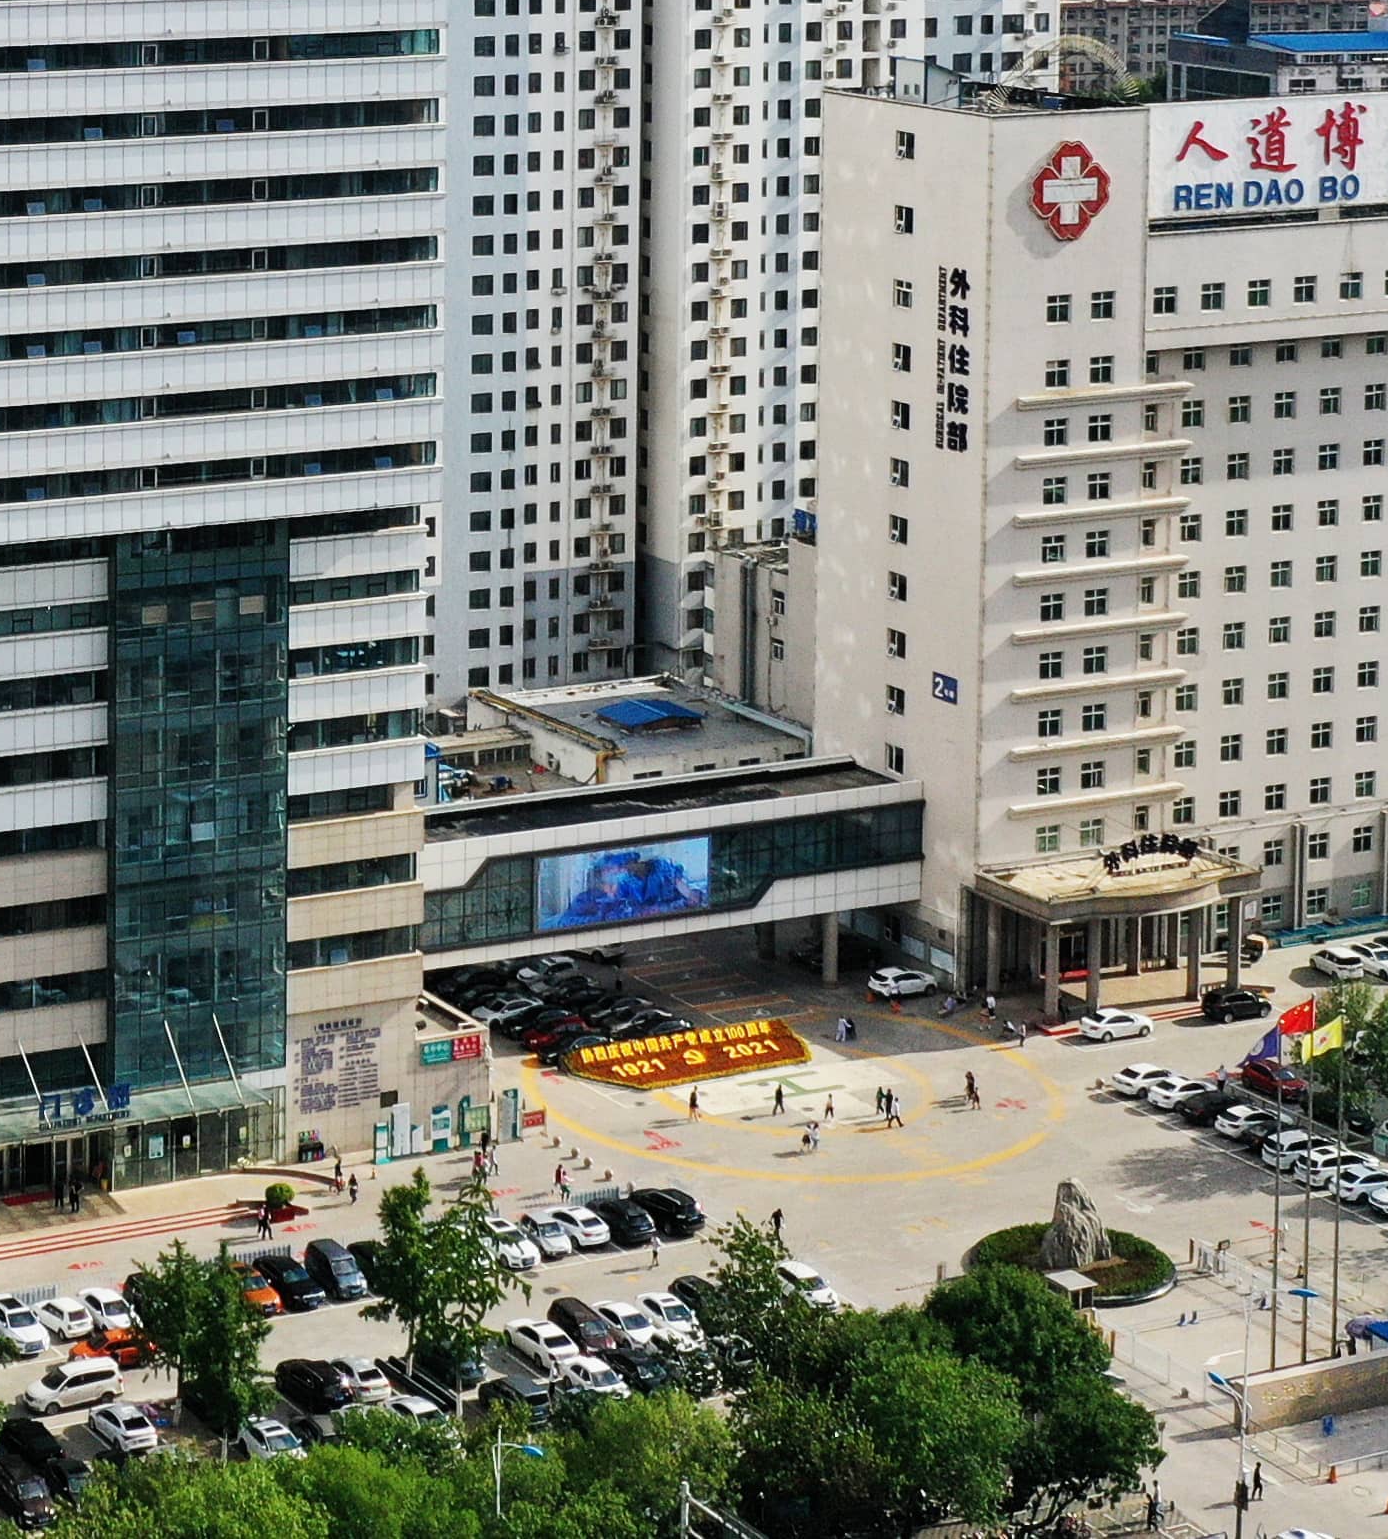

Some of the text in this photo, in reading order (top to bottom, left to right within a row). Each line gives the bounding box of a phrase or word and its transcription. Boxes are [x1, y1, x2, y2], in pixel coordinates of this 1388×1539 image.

[1174, 182, 1233, 211] REN
[1243, 178, 1304, 207] DAO
[1319, 174, 1359, 202] BO
[947, 267, 970, 453] 外科住院部
[612, 1040, 780, 1078] 1921 2021
